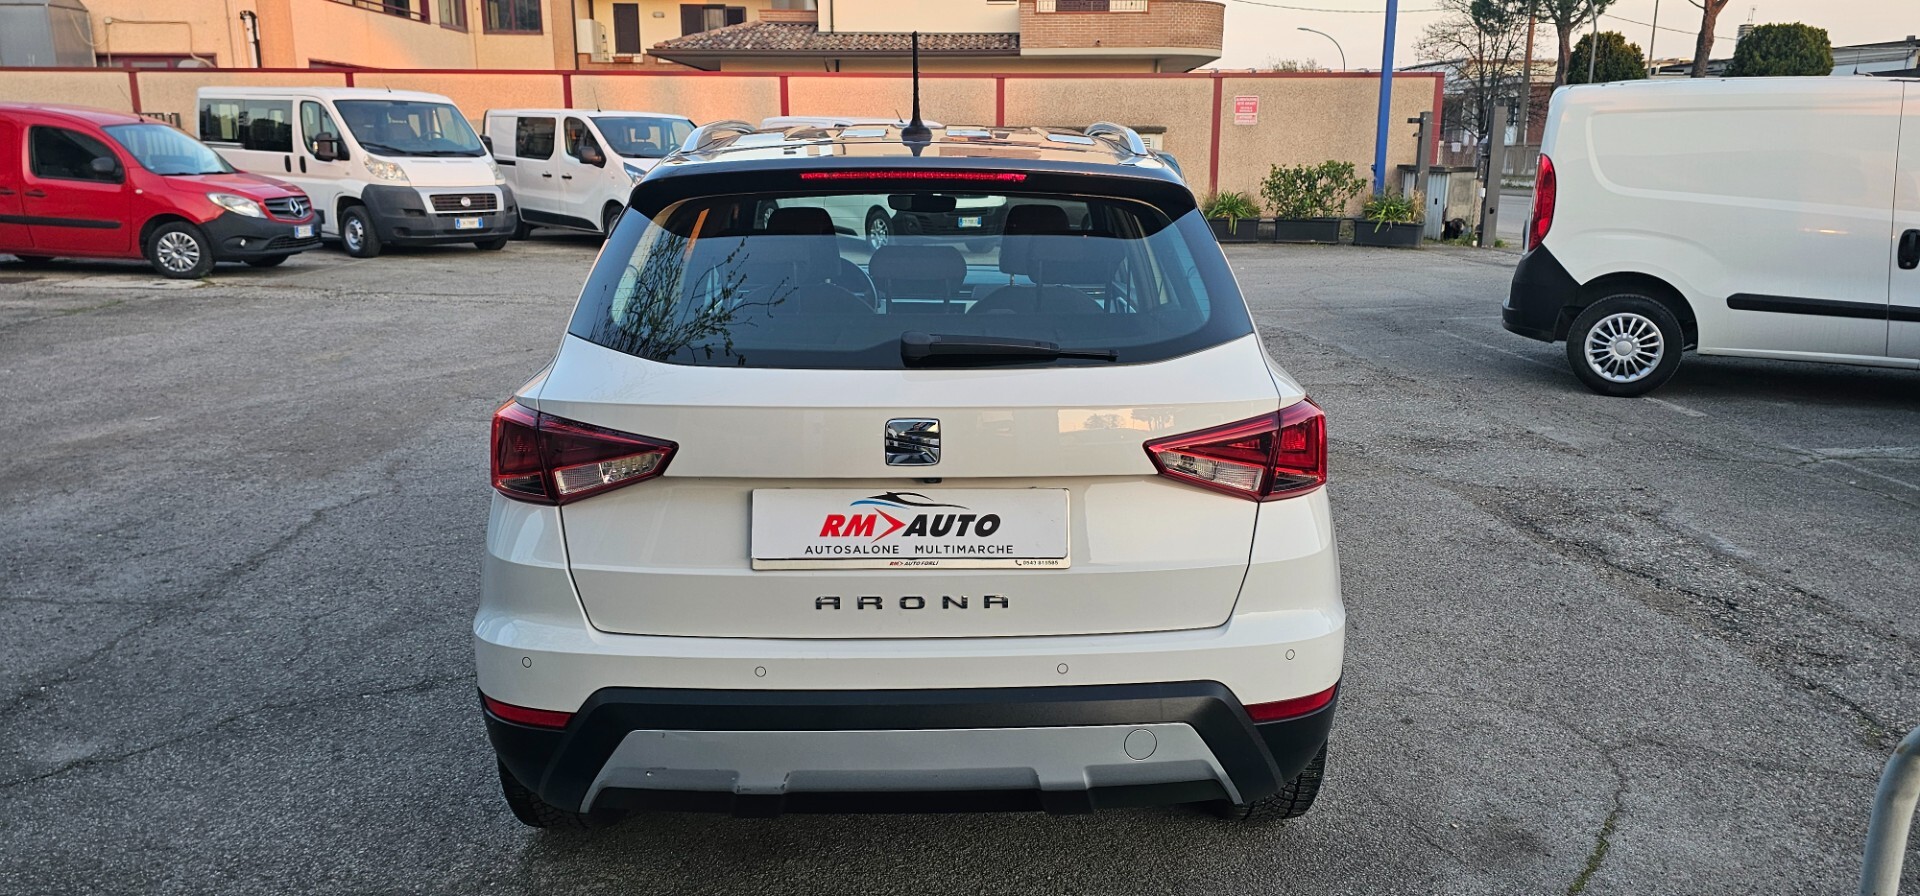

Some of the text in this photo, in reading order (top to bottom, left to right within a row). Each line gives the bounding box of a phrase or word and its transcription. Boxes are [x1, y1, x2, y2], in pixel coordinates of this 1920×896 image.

[820, 513, 1001, 537] RM AUTO
[804, 544, 1014, 555] AUTOSALONE MULTIMARCHE
[815, 594, 1010, 611] ARONA
